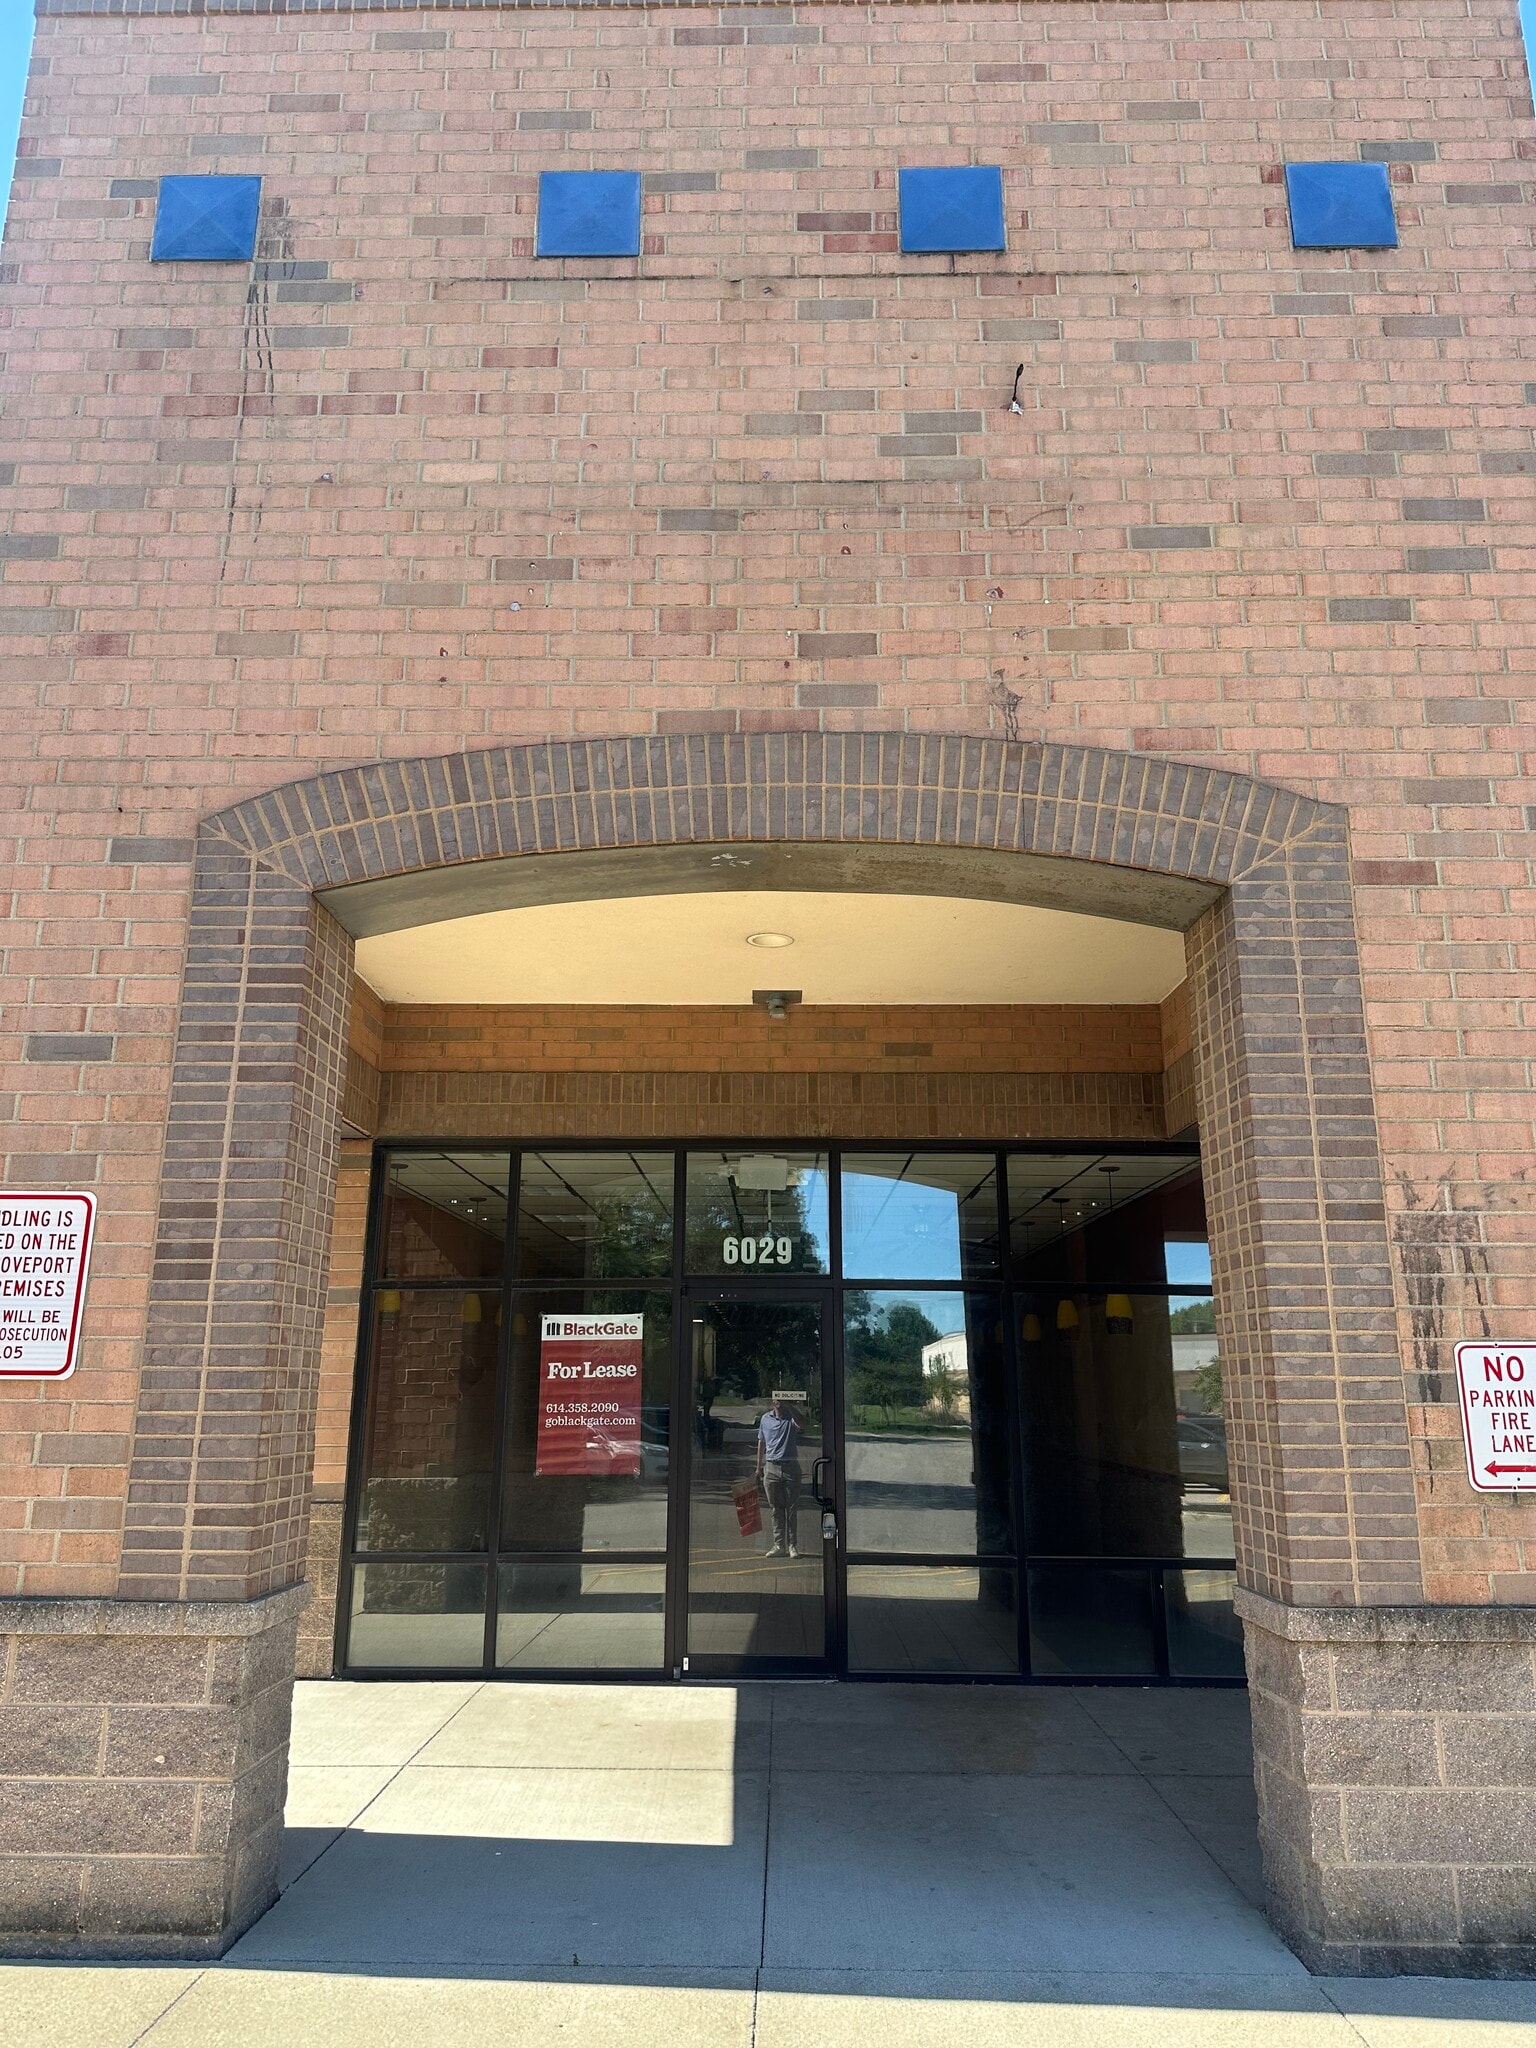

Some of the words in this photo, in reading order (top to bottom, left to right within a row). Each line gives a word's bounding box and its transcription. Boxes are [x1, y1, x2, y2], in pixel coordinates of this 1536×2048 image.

[0, 1210, 51, 1227] DLING
[57, 1210, 74, 1227] IS
[21, 1233, 43, 1250] ON
[49, 1233, 78, 1250] THE
[723, 1236, 792, 1265] 6029
[1, 1256, 75, 1274] OVEPORT
[0, 1280, 65, 1297] EMISES
[3, 1310, 36, 1323] WILL
[41, 1310, 61, 1323] BE
[0, 1327, 68, 1342] OSECUTION
[563, 1322, 638, 1336] BlackGate
[547, 1362, 582, 1379] For
[583, 1361, 637, 1378] Lease
[1483, 1355, 1525, 1382] NO
[1469, 1390, 1535, 1407] PARKIN
[546, 1402, 619, 1413] 614.358.2090
[545, 1415, 636, 1428] goblackgate.com
[1491, 1412, 1531, 1430] FIRE
[1491, 1435, 1536, 1452] LANE
